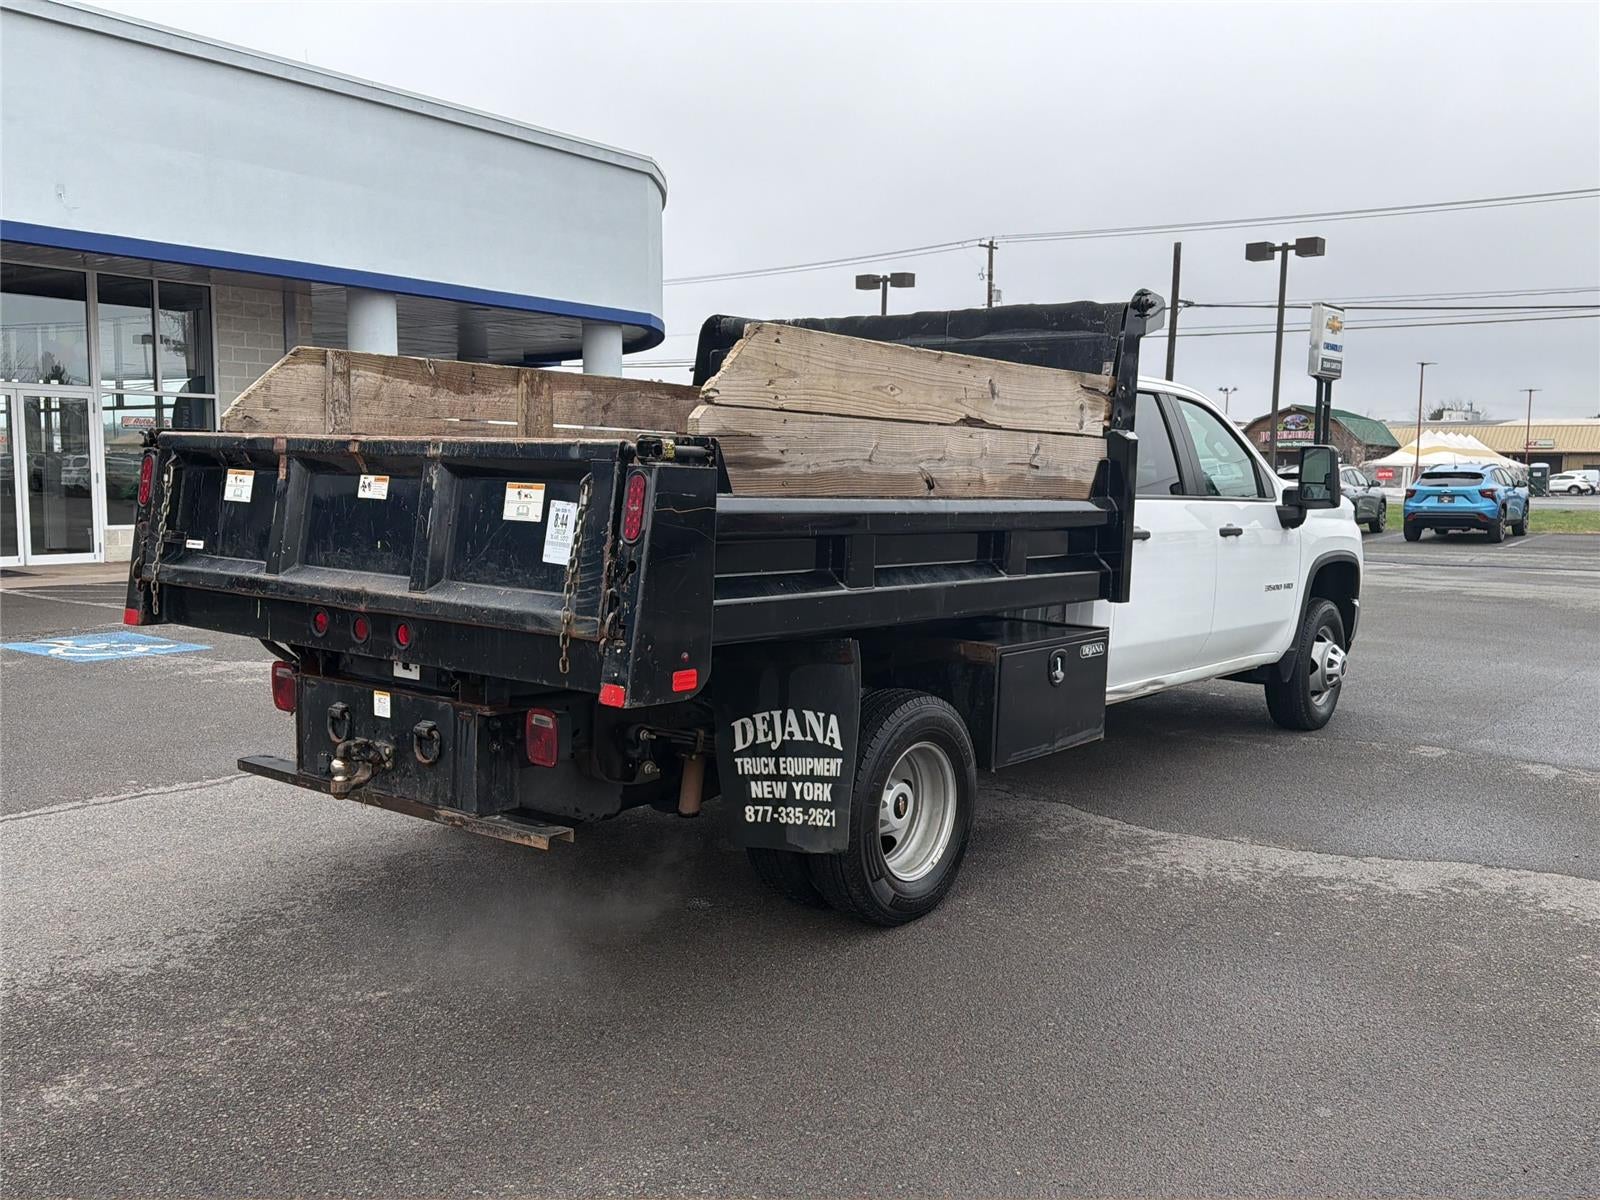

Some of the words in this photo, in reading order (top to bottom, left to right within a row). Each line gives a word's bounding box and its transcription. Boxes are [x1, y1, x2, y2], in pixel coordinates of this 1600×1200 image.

[1264, 584, 1282, 592] 3500
[731, 708, 843, 752] DEJANA
[735, 757, 777, 776] TRUCK
[779, 757, 843, 777] EQUIPMENT
[750, 781, 787, 799] NEW
[792, 782, 832, 802] YORK
[744, 805, 836, 828] 877-335-2621
